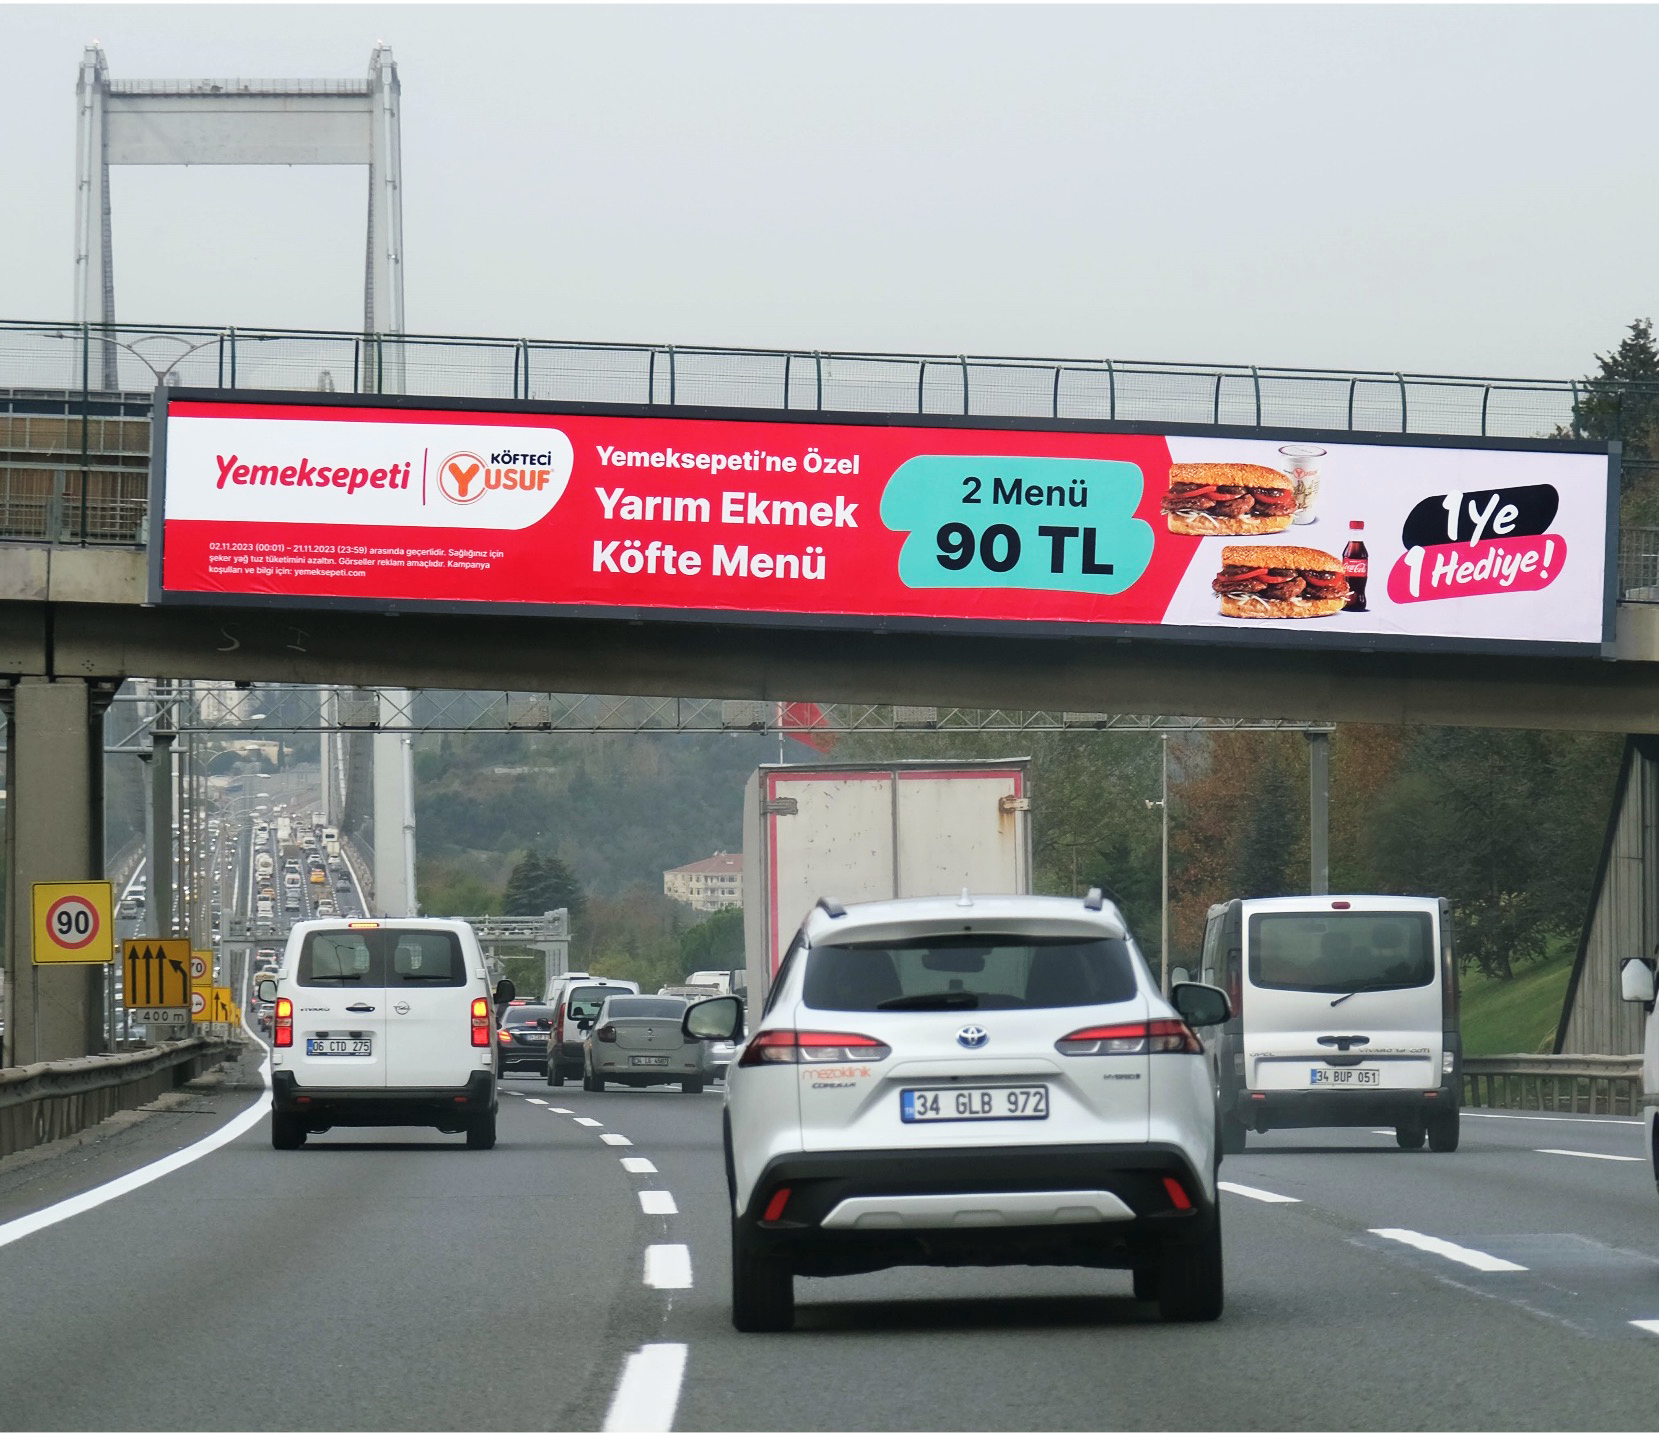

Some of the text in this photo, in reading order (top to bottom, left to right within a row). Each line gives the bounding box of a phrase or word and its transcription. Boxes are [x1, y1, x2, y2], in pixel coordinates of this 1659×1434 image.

[491, 450, 552, 466] KÖFTECİ
[596, 445, 860, 474] Yemeksepeti'ne Özel
[216, 454, 410, 494] Yemeksepeti
[962, 476, 1088, 508] 2 Menü
[594, 487, 860, 528] Yarım Ekmek
[210, 542, 254, 551] 02.11.2023
[256, 543, 284, 552] (00:01)
[294, 544, 336, 553] 21.11.2023
[338, 545, 367, 554] (23:59)
[592, 540, 826, 580] Köfte Menü
[936, 522, 1114, 575] 90 TL
[256, 566, 274, 576] bilgi
[294, 568, 366, 578] yemeksepeti.com
[1404, 539, 1555, 598] 1 Hediye!
[57, 910, 90, 934] 90
[143, 1011, 184, 1022] 400 m
[312, 1041, 370, 1052] 06 CTD 275
[1317, 1070, 1376, 1083] 34 BUP 051
[916, 1091, 1045, 1116] 34 GLB 972
